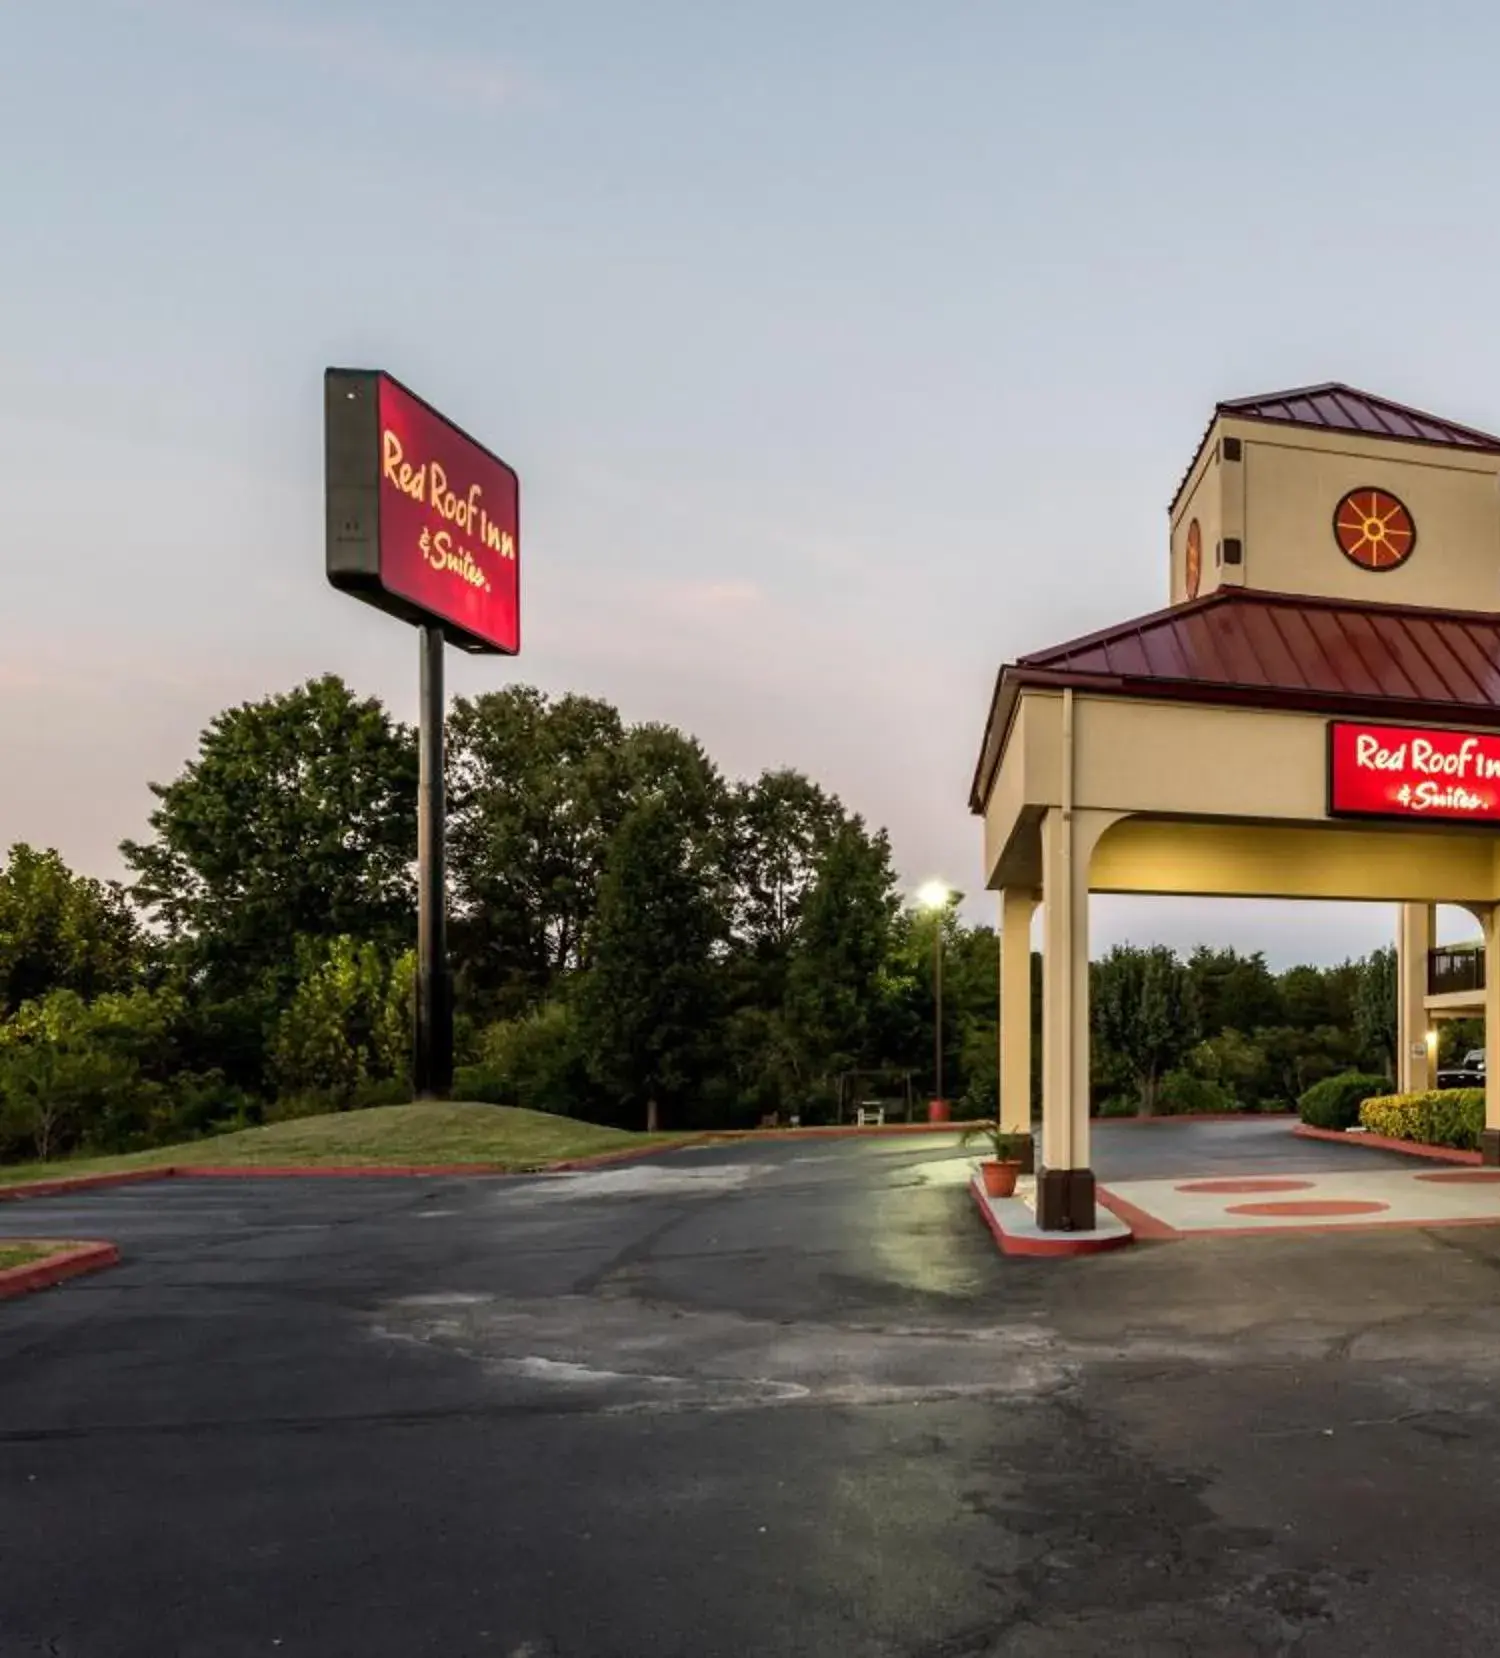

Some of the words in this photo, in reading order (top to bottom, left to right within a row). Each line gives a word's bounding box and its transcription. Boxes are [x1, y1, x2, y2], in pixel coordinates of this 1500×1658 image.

[383, 429, 425, 501] Red
[431, 461, 481, 536] Roof
[481, 511, 515, 560] Inn
[1356, 734, 1406, 771] Red
[1411, 738, 1478, 778] Roof
